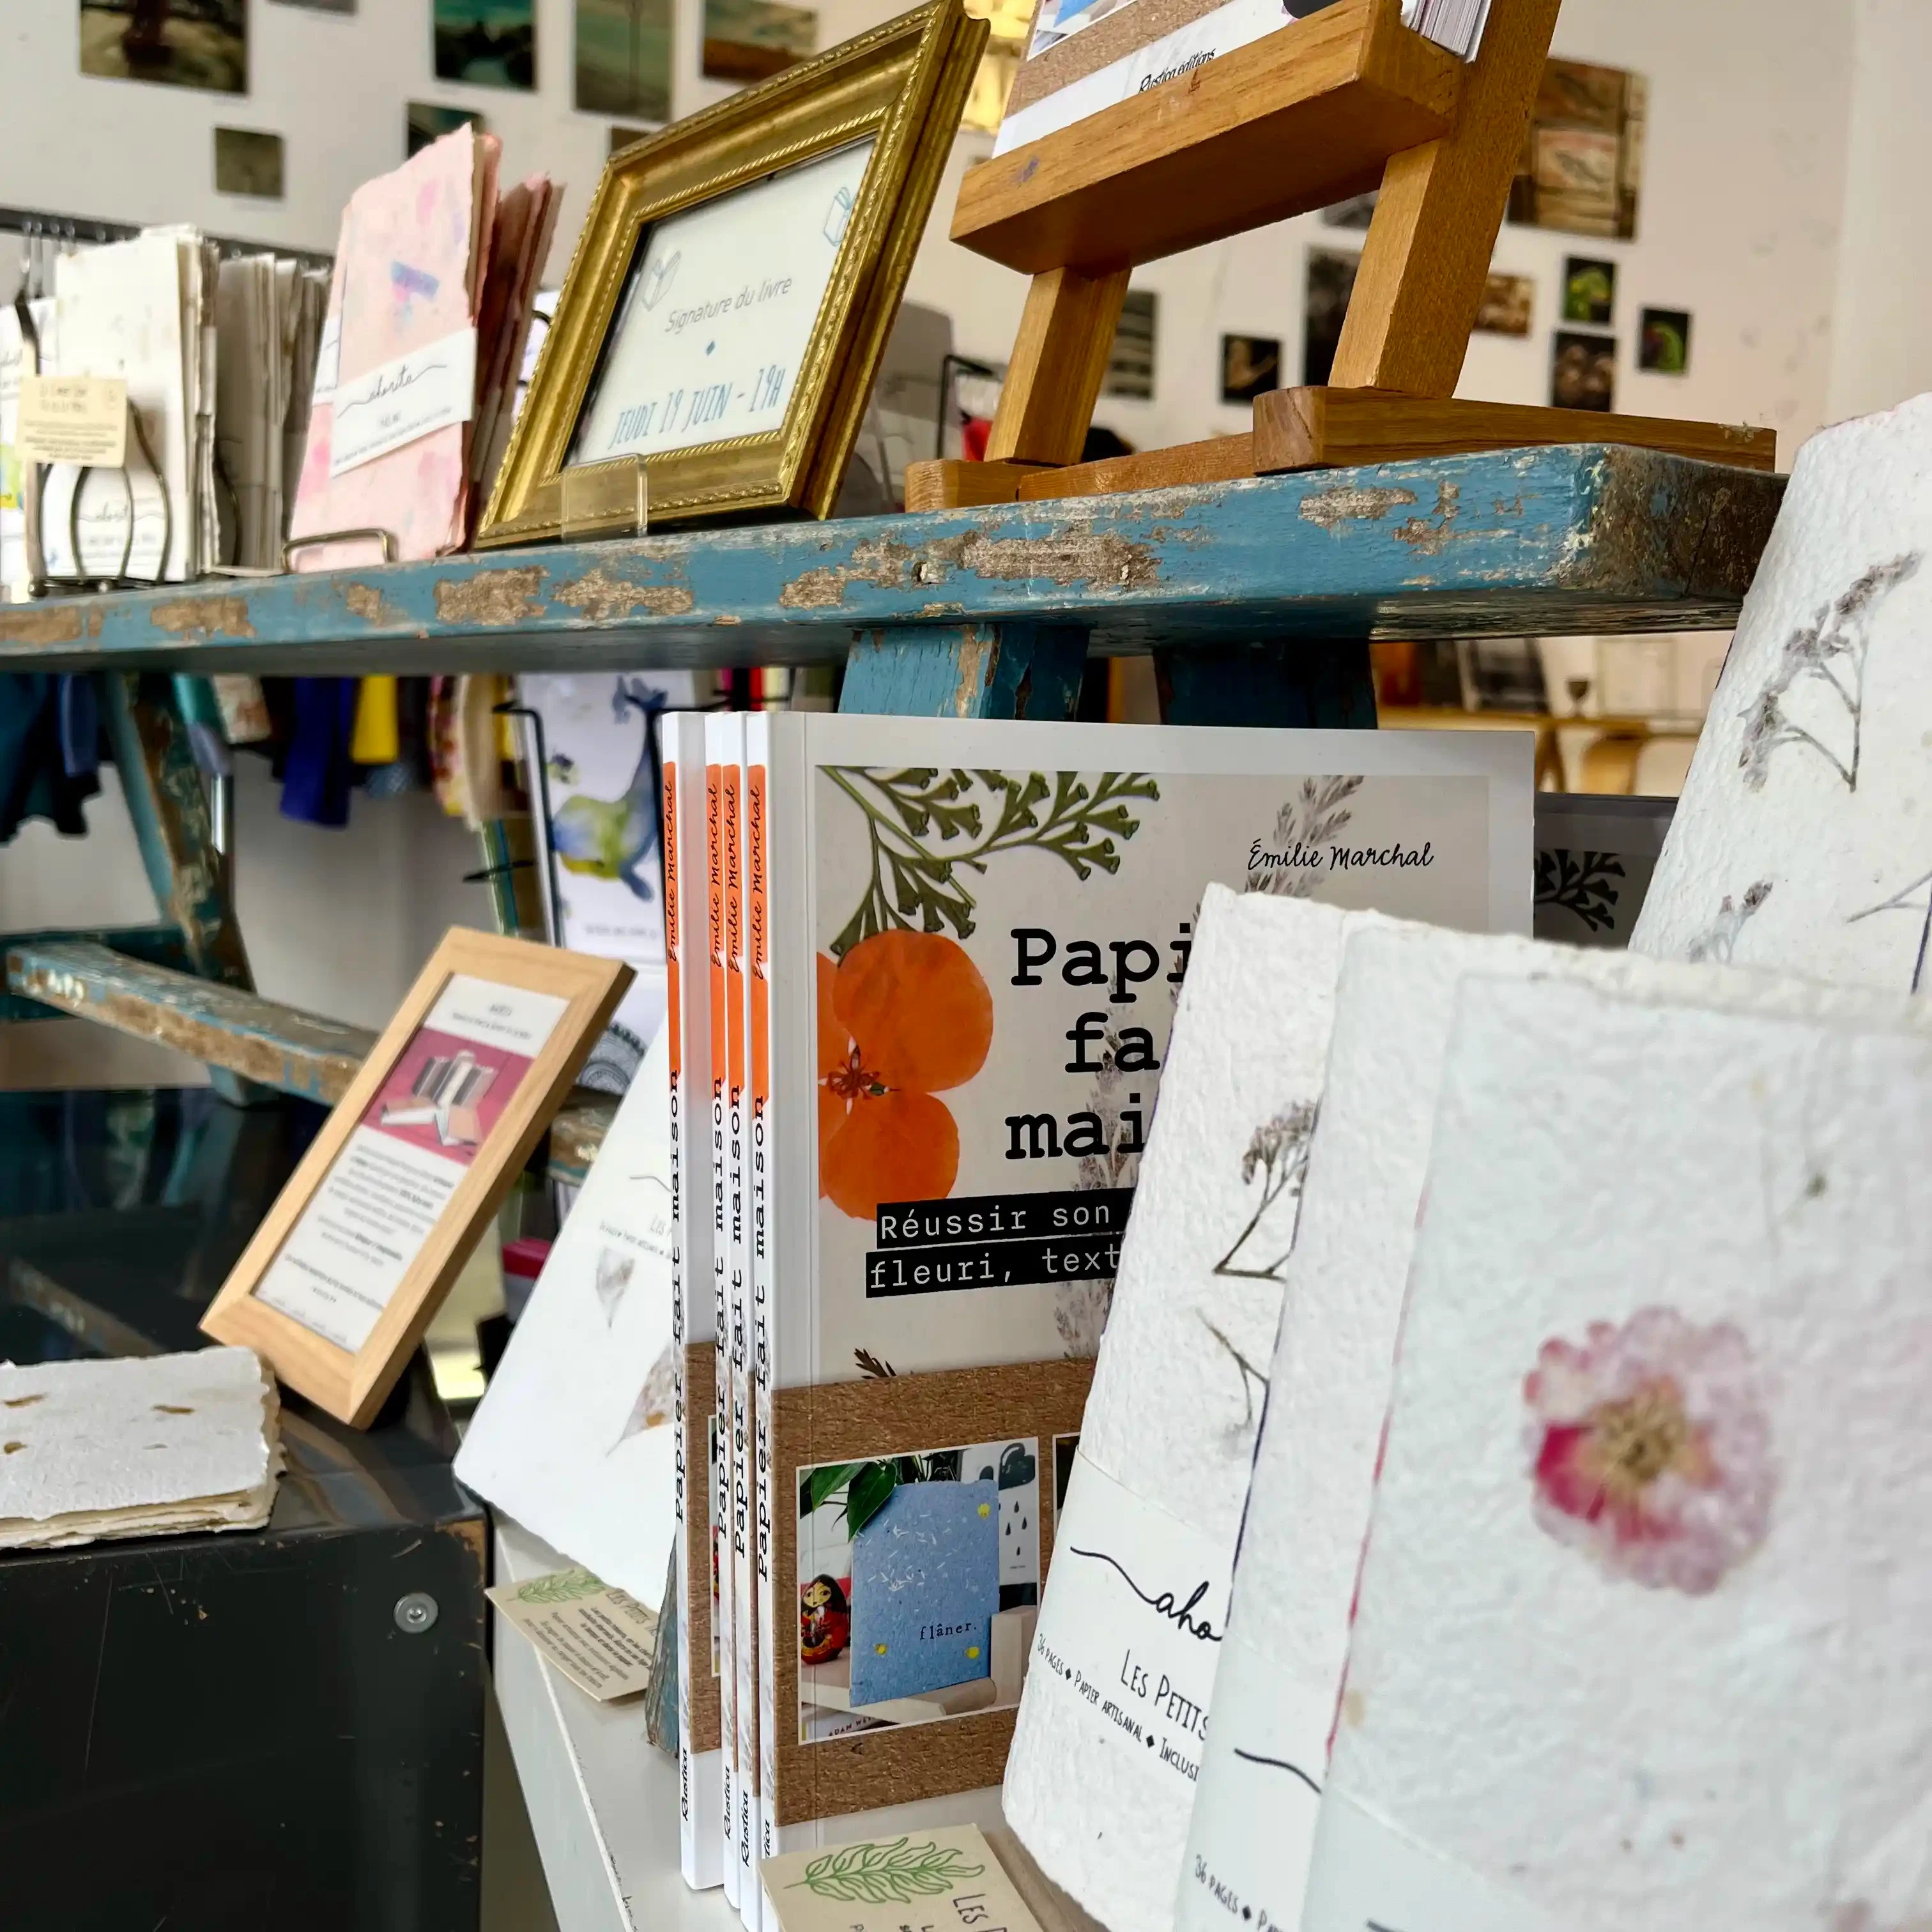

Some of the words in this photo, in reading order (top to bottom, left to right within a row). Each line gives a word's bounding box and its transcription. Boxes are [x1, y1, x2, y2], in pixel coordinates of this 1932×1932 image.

[664, 297, 733, 335] Signature
[735, 286, 755, 309] du
[758, 277, 792, 302] livre
[608, 401, 658, 450] JEUDI
[659, 388, 684, 433] 19
[681, 382, 733, 433] JUIN
[749, 364, 786, 413] 19H
[665, 781, 675, 882] Marchal
[708, 783, 721, 887] Marchal
[724, 784, 739, 889] Marchal
[749, 785, 763, 894] Marchal
[1247, 838, 1324, 871] Émilie
[1330, 841, 1434, 871] Marchal
[1010, 923, 1192, 1003] Papi
[1064, 1011, 1161, 1073] fa
[670, 1070, 679, 1222] maison
[713, 1077, 723, 1232] maison
[730, 1085, 742, 1245] maison
[1005, 1092, 1145, 1160] mai
[753, 1096, 765, 1259] maison
[881, 1205, 1026, 1239] Réussir
[1053, 1204, 1110, 1227] son
[672, 1246, 681, 1346] fait
[715, 1256, 724, 1358] fait
[870, 1252, 1011, 1289] fleuri,
[1042, 1243, 1120, 1273] text
[732, 1269, 743, 1372] fait
[755, 1285, 765, 1392] fait
[675, 1372, 685, 1524] Papier
[718, 1384, 729, 1539] Papier
[734, 1399, 747, 1559] Papier
[756, 1418, 770, 1583] Papier
[920, 1623, 977, 1641] flâner.
[1038, 1633, 1046, 1655] 36
[741, 1790, 749, 1867] Rustica
[1195, 1853, 1208, 1884] 36
